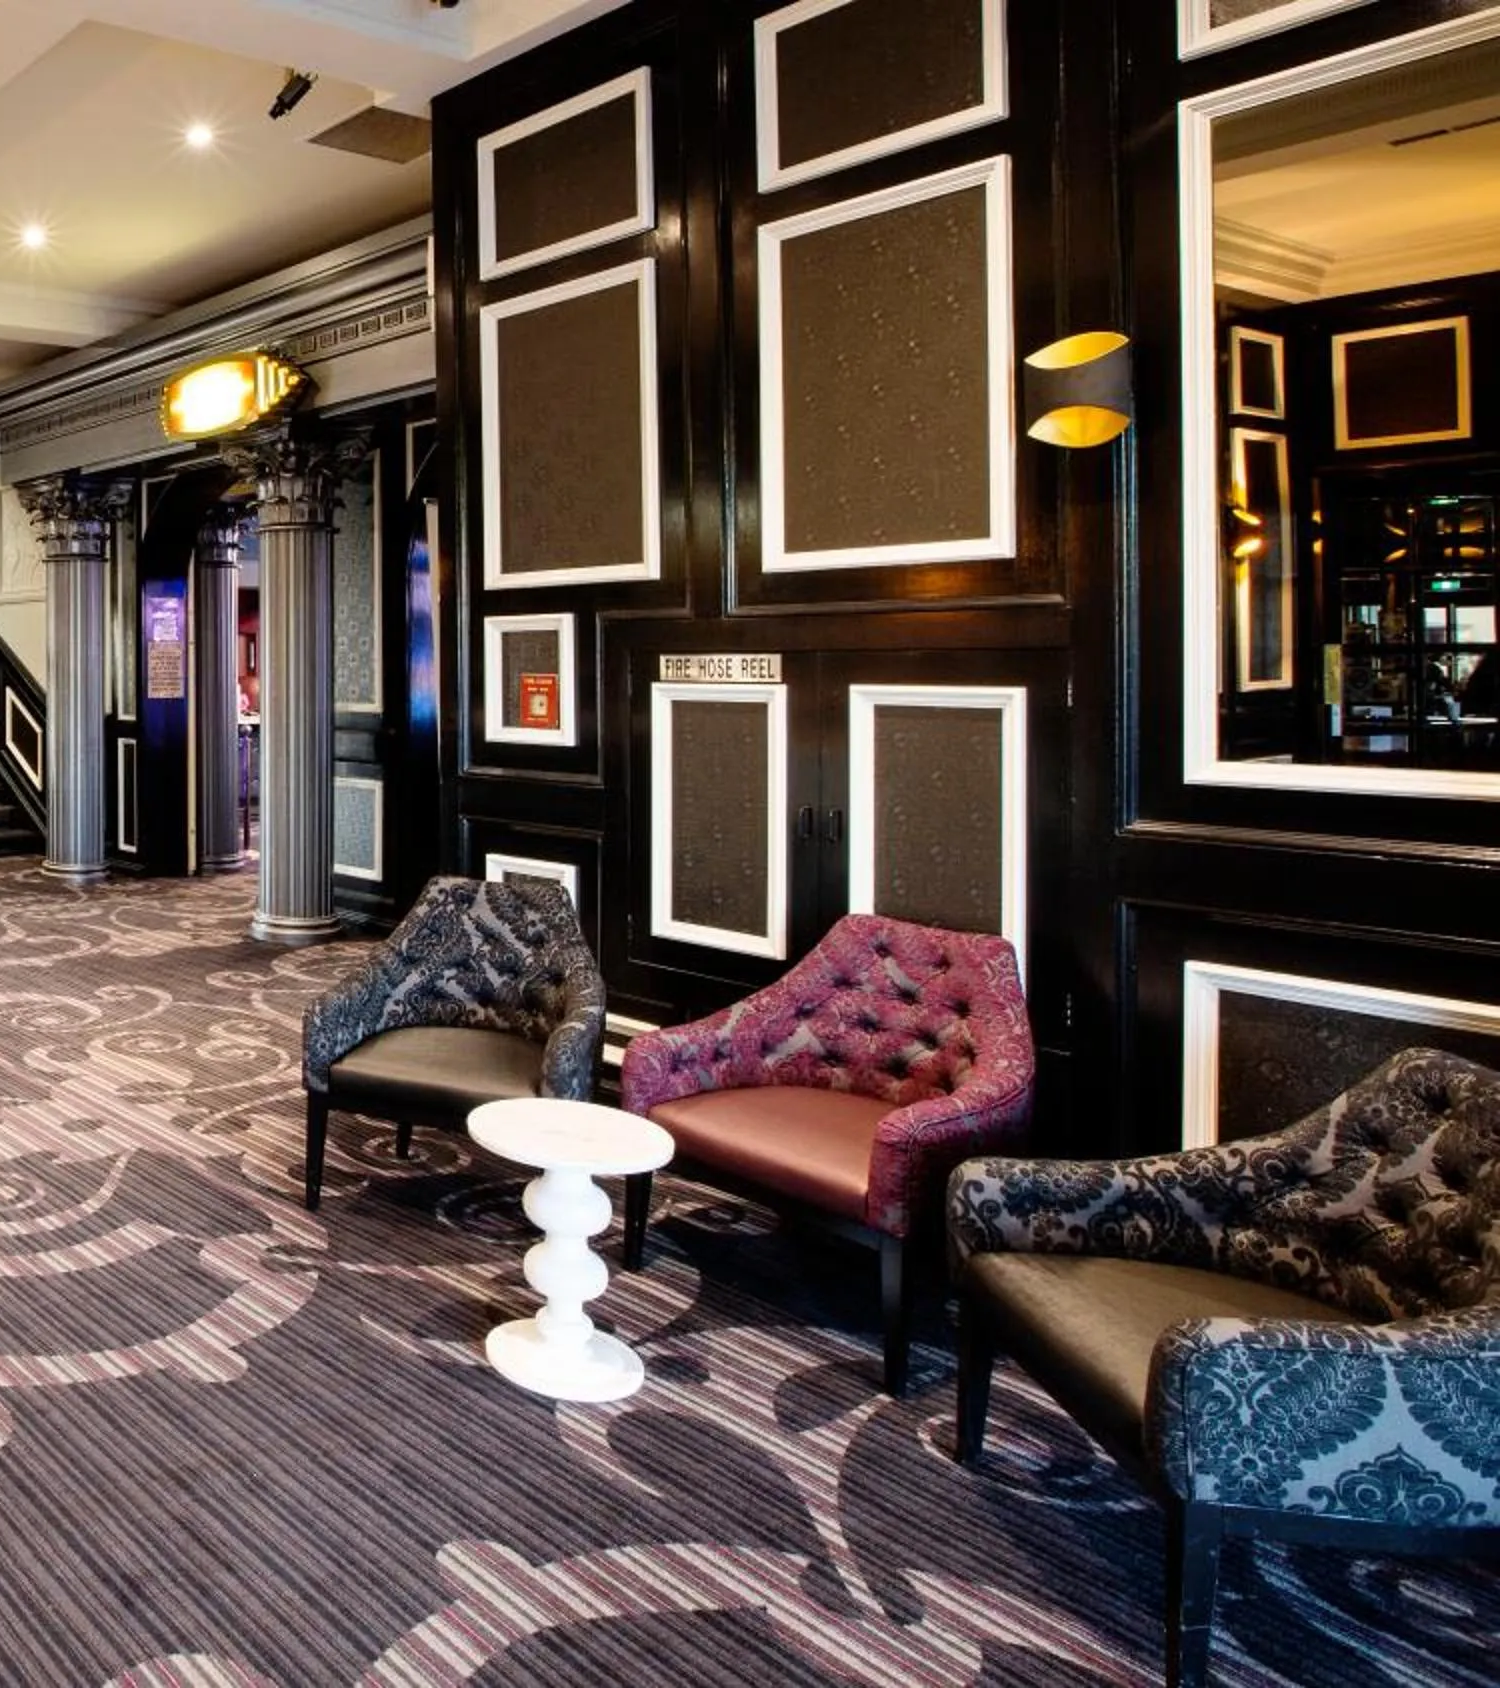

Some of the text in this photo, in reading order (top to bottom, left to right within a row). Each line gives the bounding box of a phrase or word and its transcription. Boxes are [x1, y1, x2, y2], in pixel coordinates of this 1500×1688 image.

[665, 658, 775, 678] FIRE HOSE REEL
